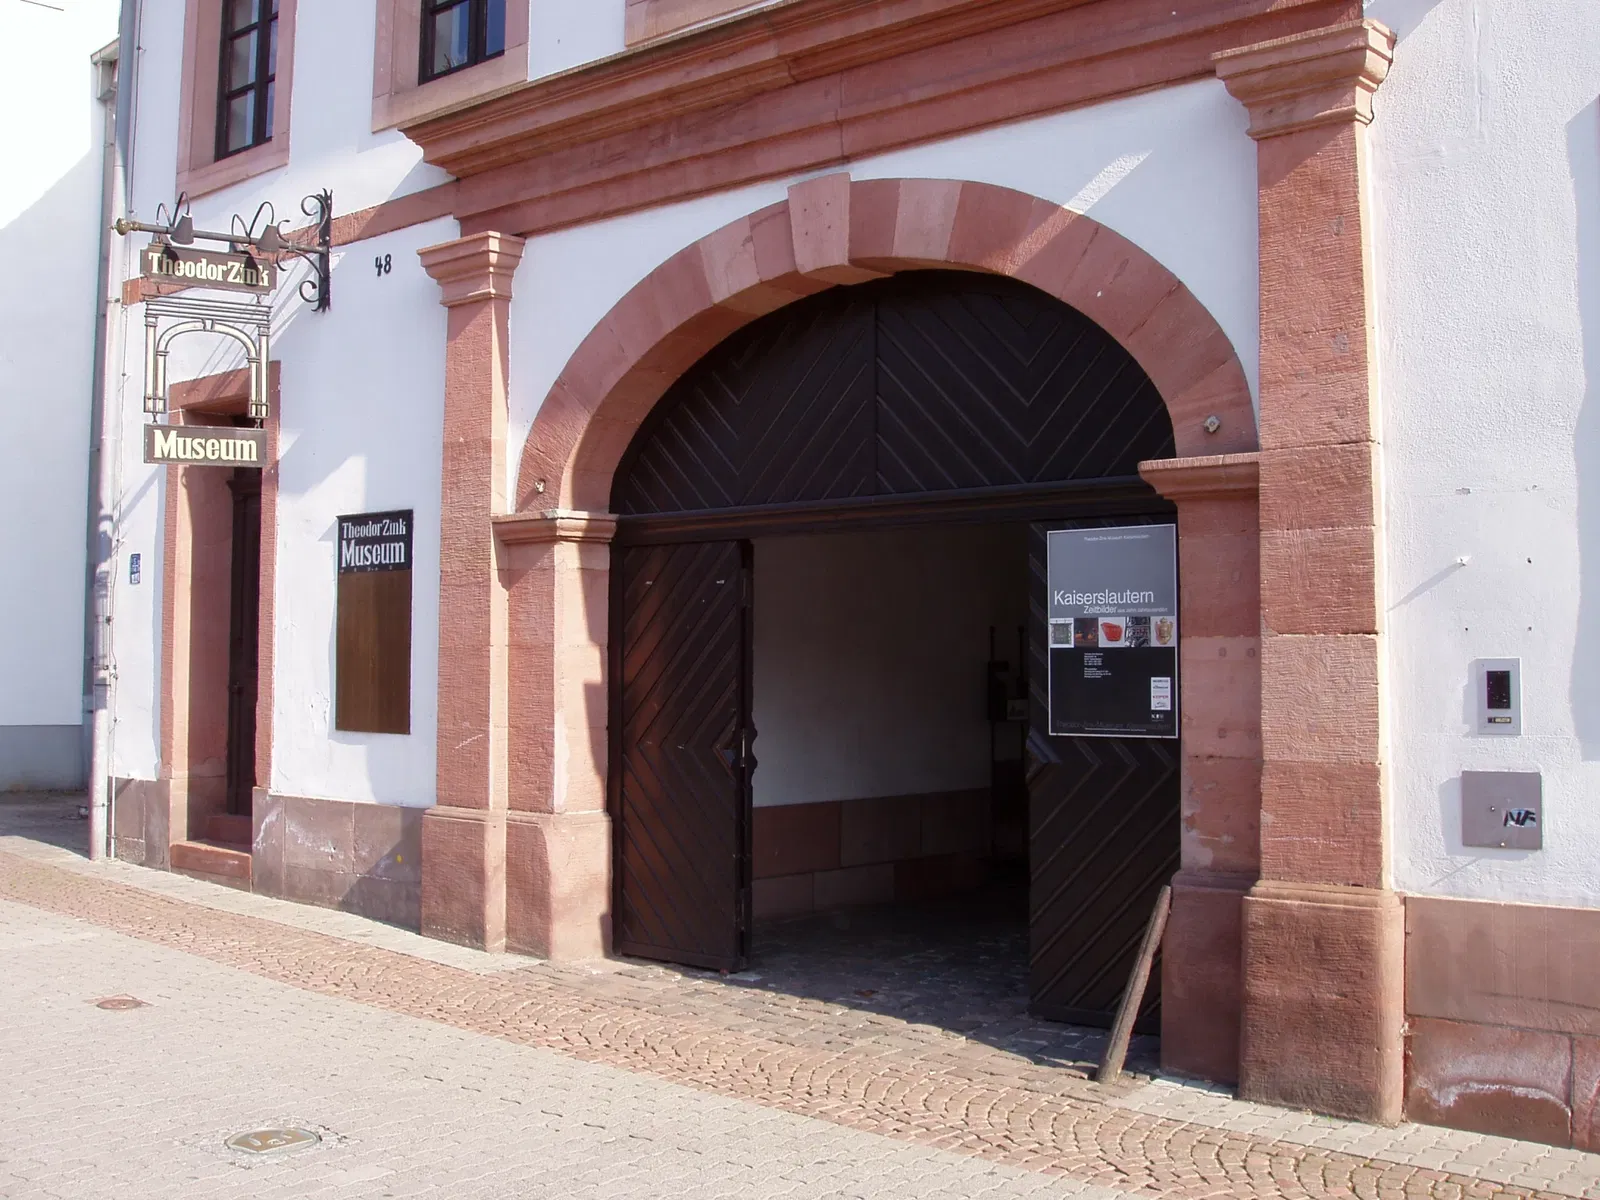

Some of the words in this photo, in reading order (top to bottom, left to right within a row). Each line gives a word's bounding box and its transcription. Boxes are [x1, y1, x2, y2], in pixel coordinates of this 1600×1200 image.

[375, 253, 392, 276] 48
[153, 430, 258, 461] Museum
[341, 539, 405, 568] Museum
[1053, 589, 1154, 605] Kaiserslautern
[1083, 604, 1117, 614] Zeitbilder
